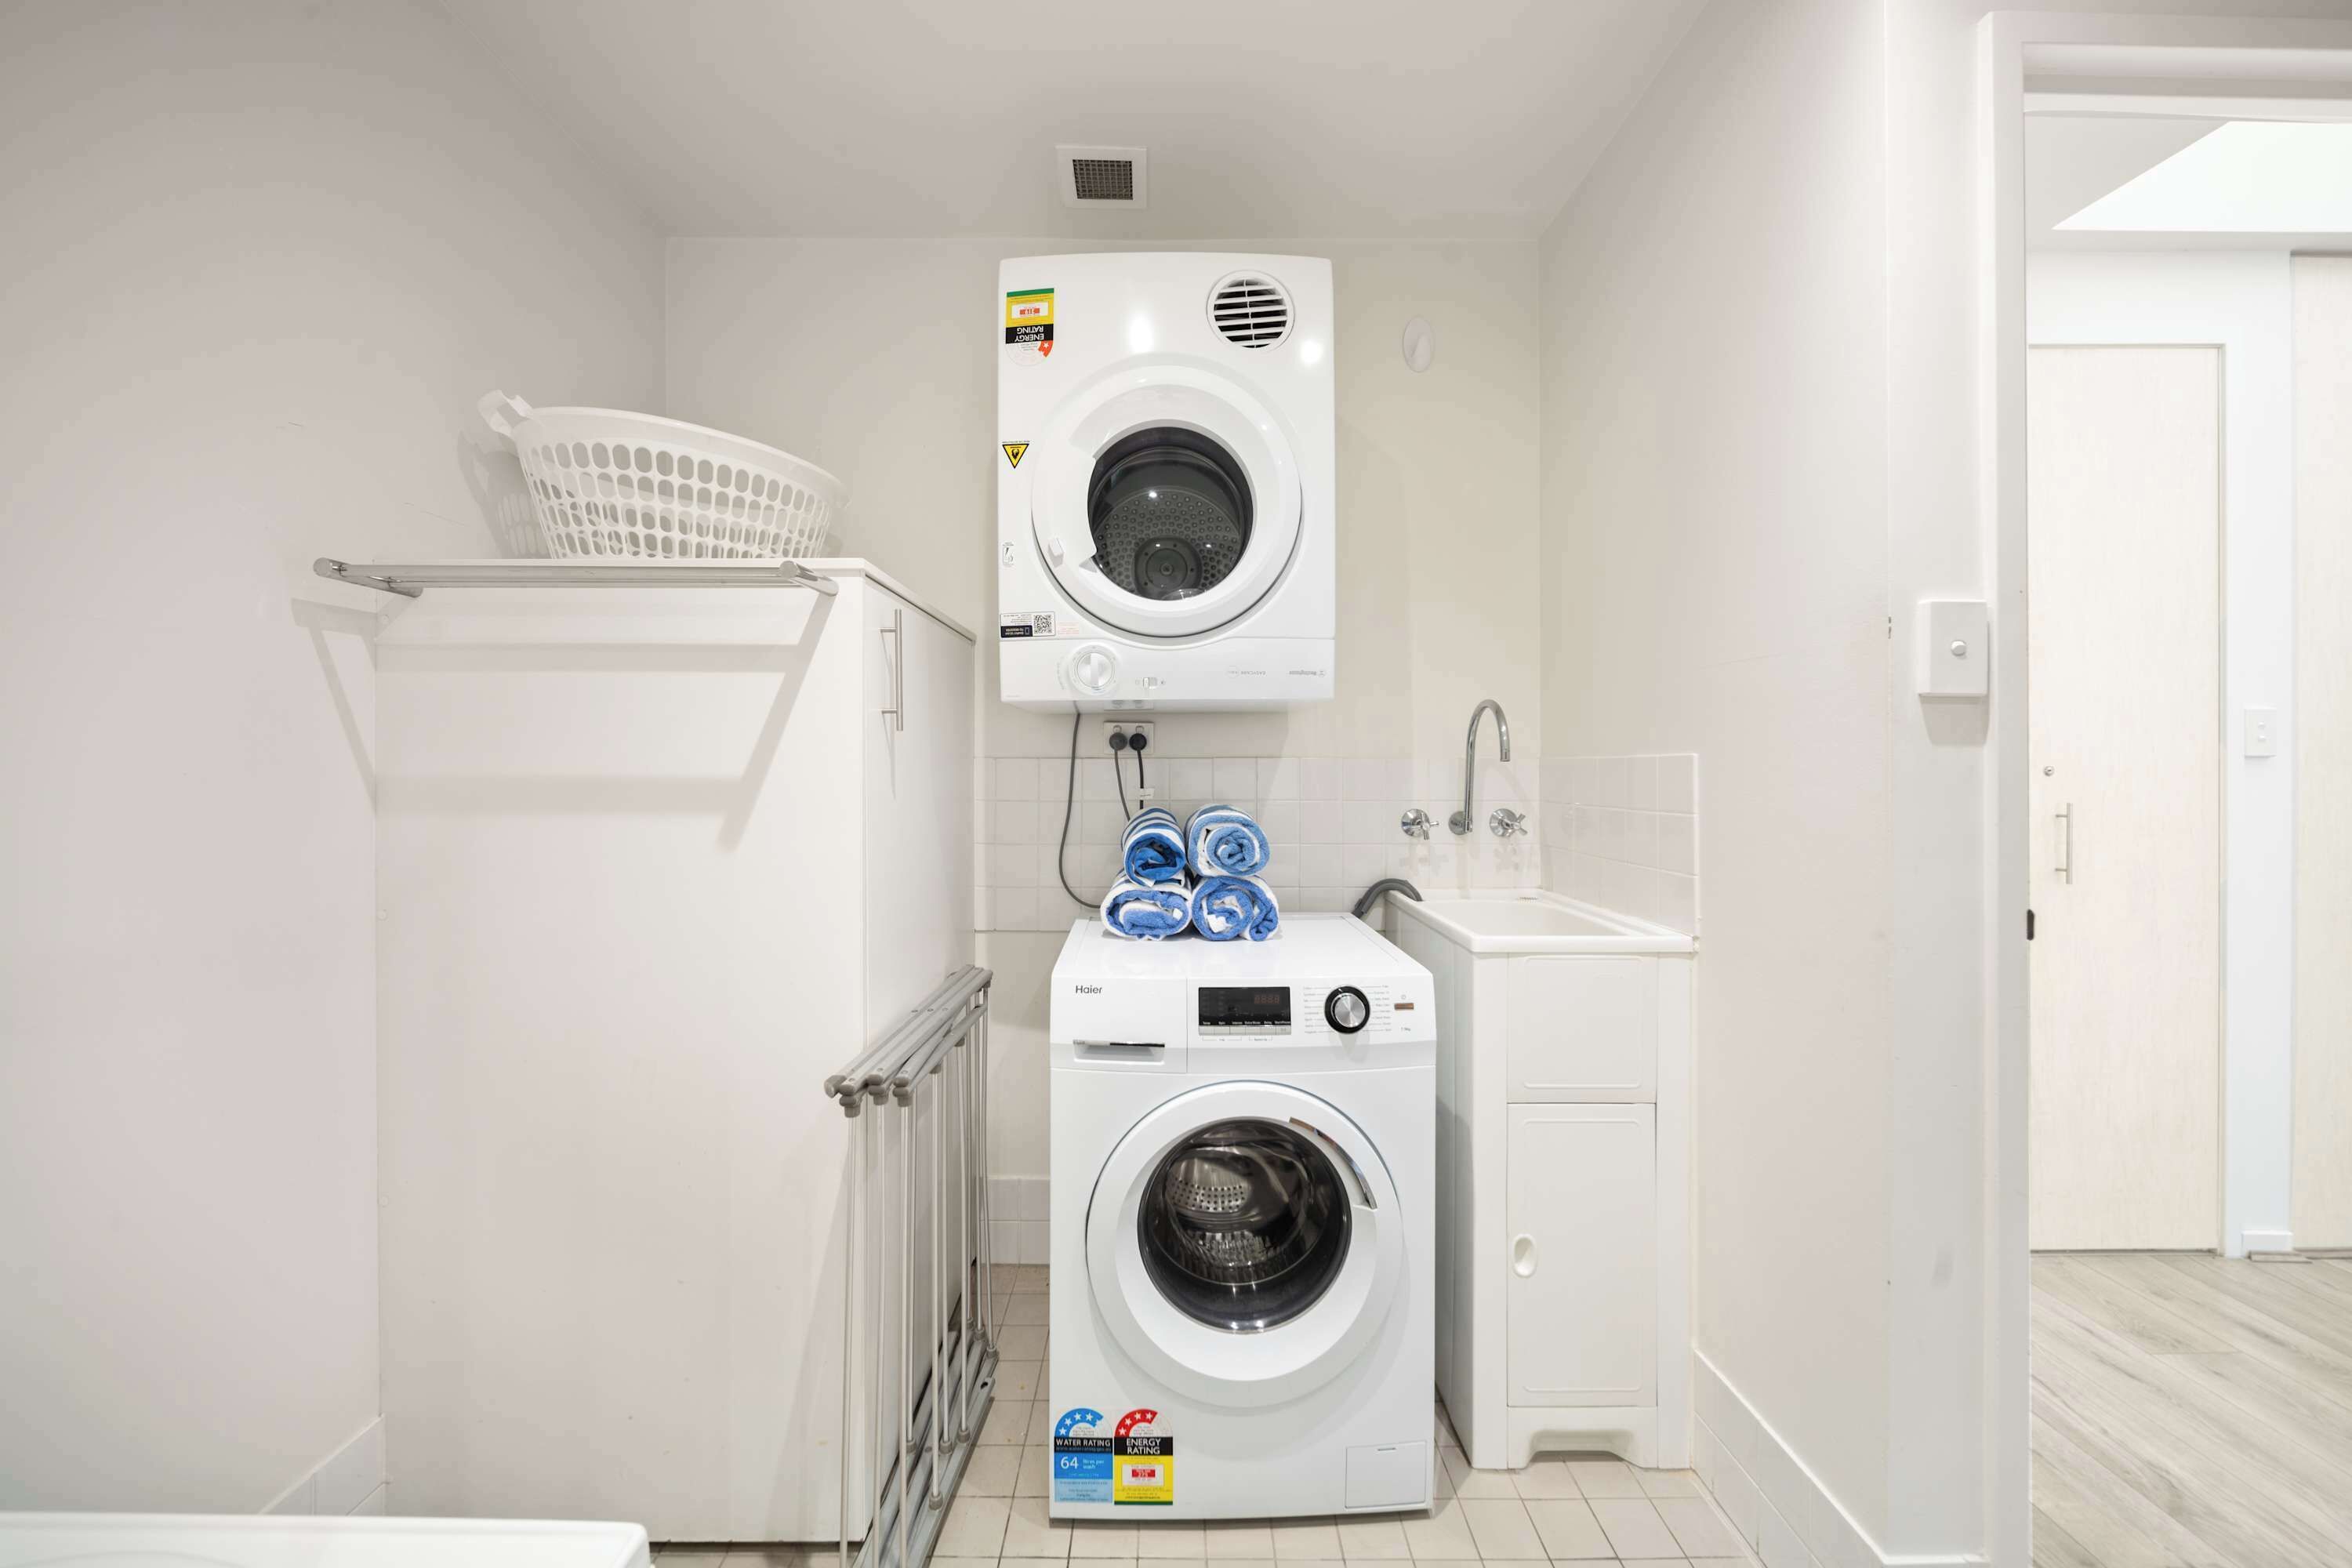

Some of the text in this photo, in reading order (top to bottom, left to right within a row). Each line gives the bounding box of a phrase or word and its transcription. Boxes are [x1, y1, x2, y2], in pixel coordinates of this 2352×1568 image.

[1017, 325, 1044, 334] RATING
[1014, 333, 1044, 343] ENERGY
[1075, 985, 1103, 994] Haier
[1126, 1438, 1161, 1446] ENERGY
[1127, 1446, 1160, 1455] RATING
[1060, 1456, 1079, 1469] 64
